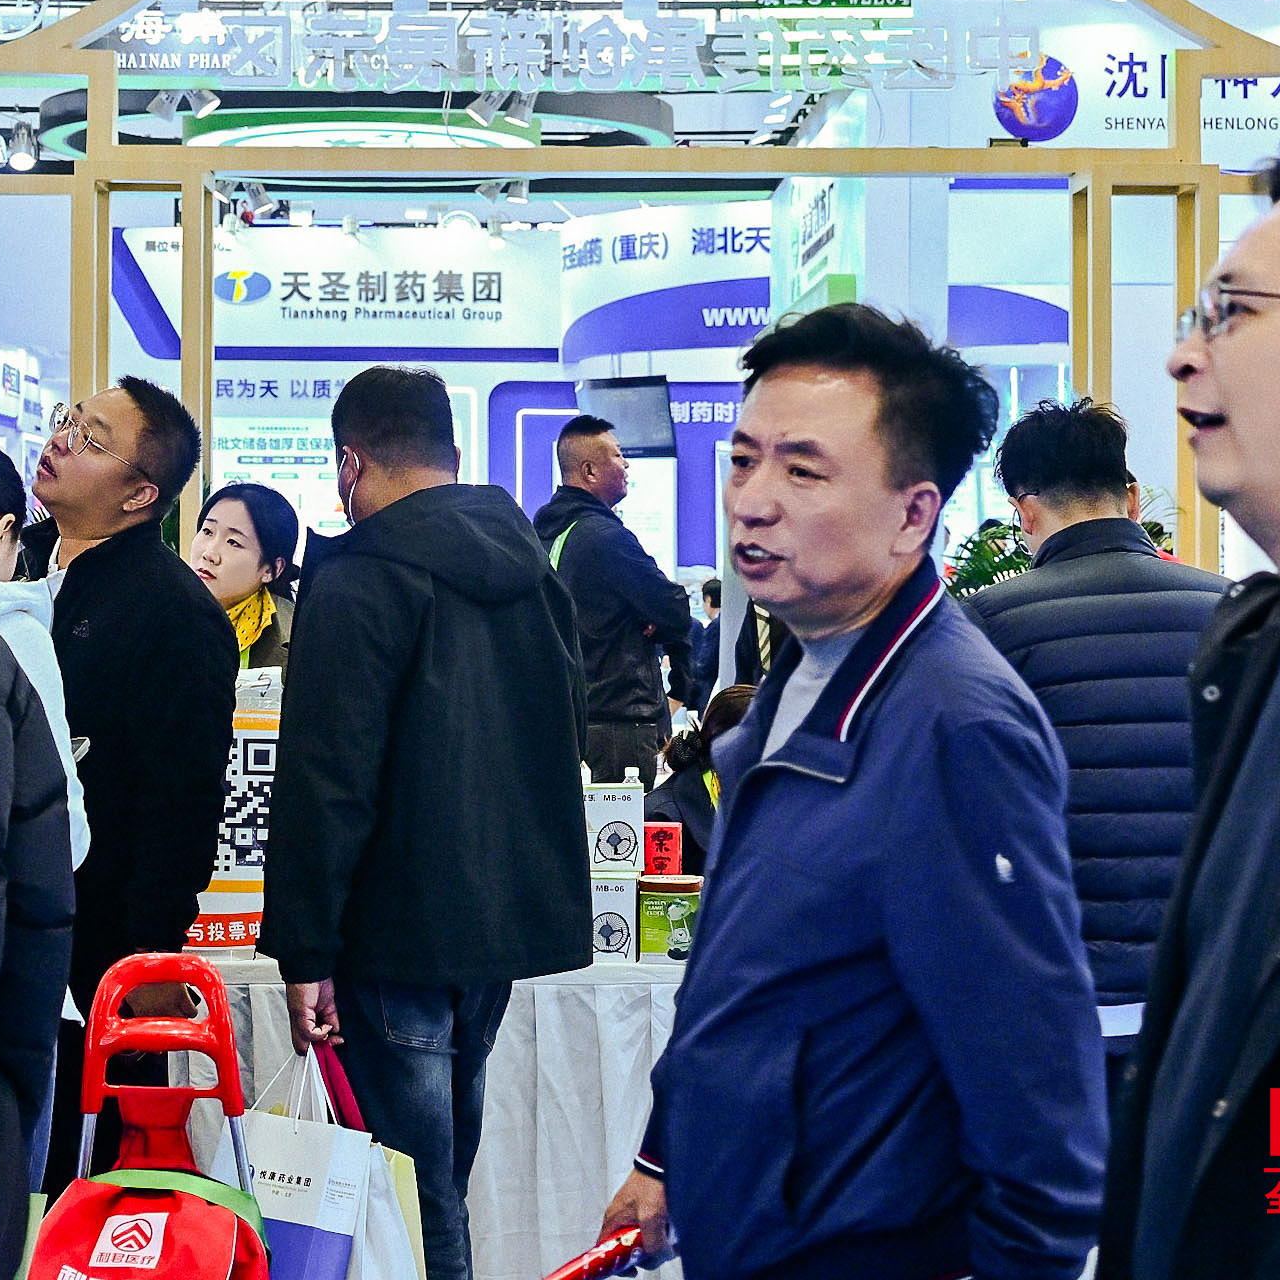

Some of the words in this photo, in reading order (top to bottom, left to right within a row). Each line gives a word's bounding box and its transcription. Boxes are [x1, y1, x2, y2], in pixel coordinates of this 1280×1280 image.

[116, 53, 182, 69] HAINAN
[1105, 116, 1166, 131] SHENYA
[1202, 116, 1279, 131] HENLONG
[281, 271, 502, 304] 天圣制药集团
[281, 306, 347, 321] Tiansheng
[355, 306, 456, 319] Pharmaceutical
[463, 307, 502, 321] Group
[603, 794, 632, 802] MB-06
